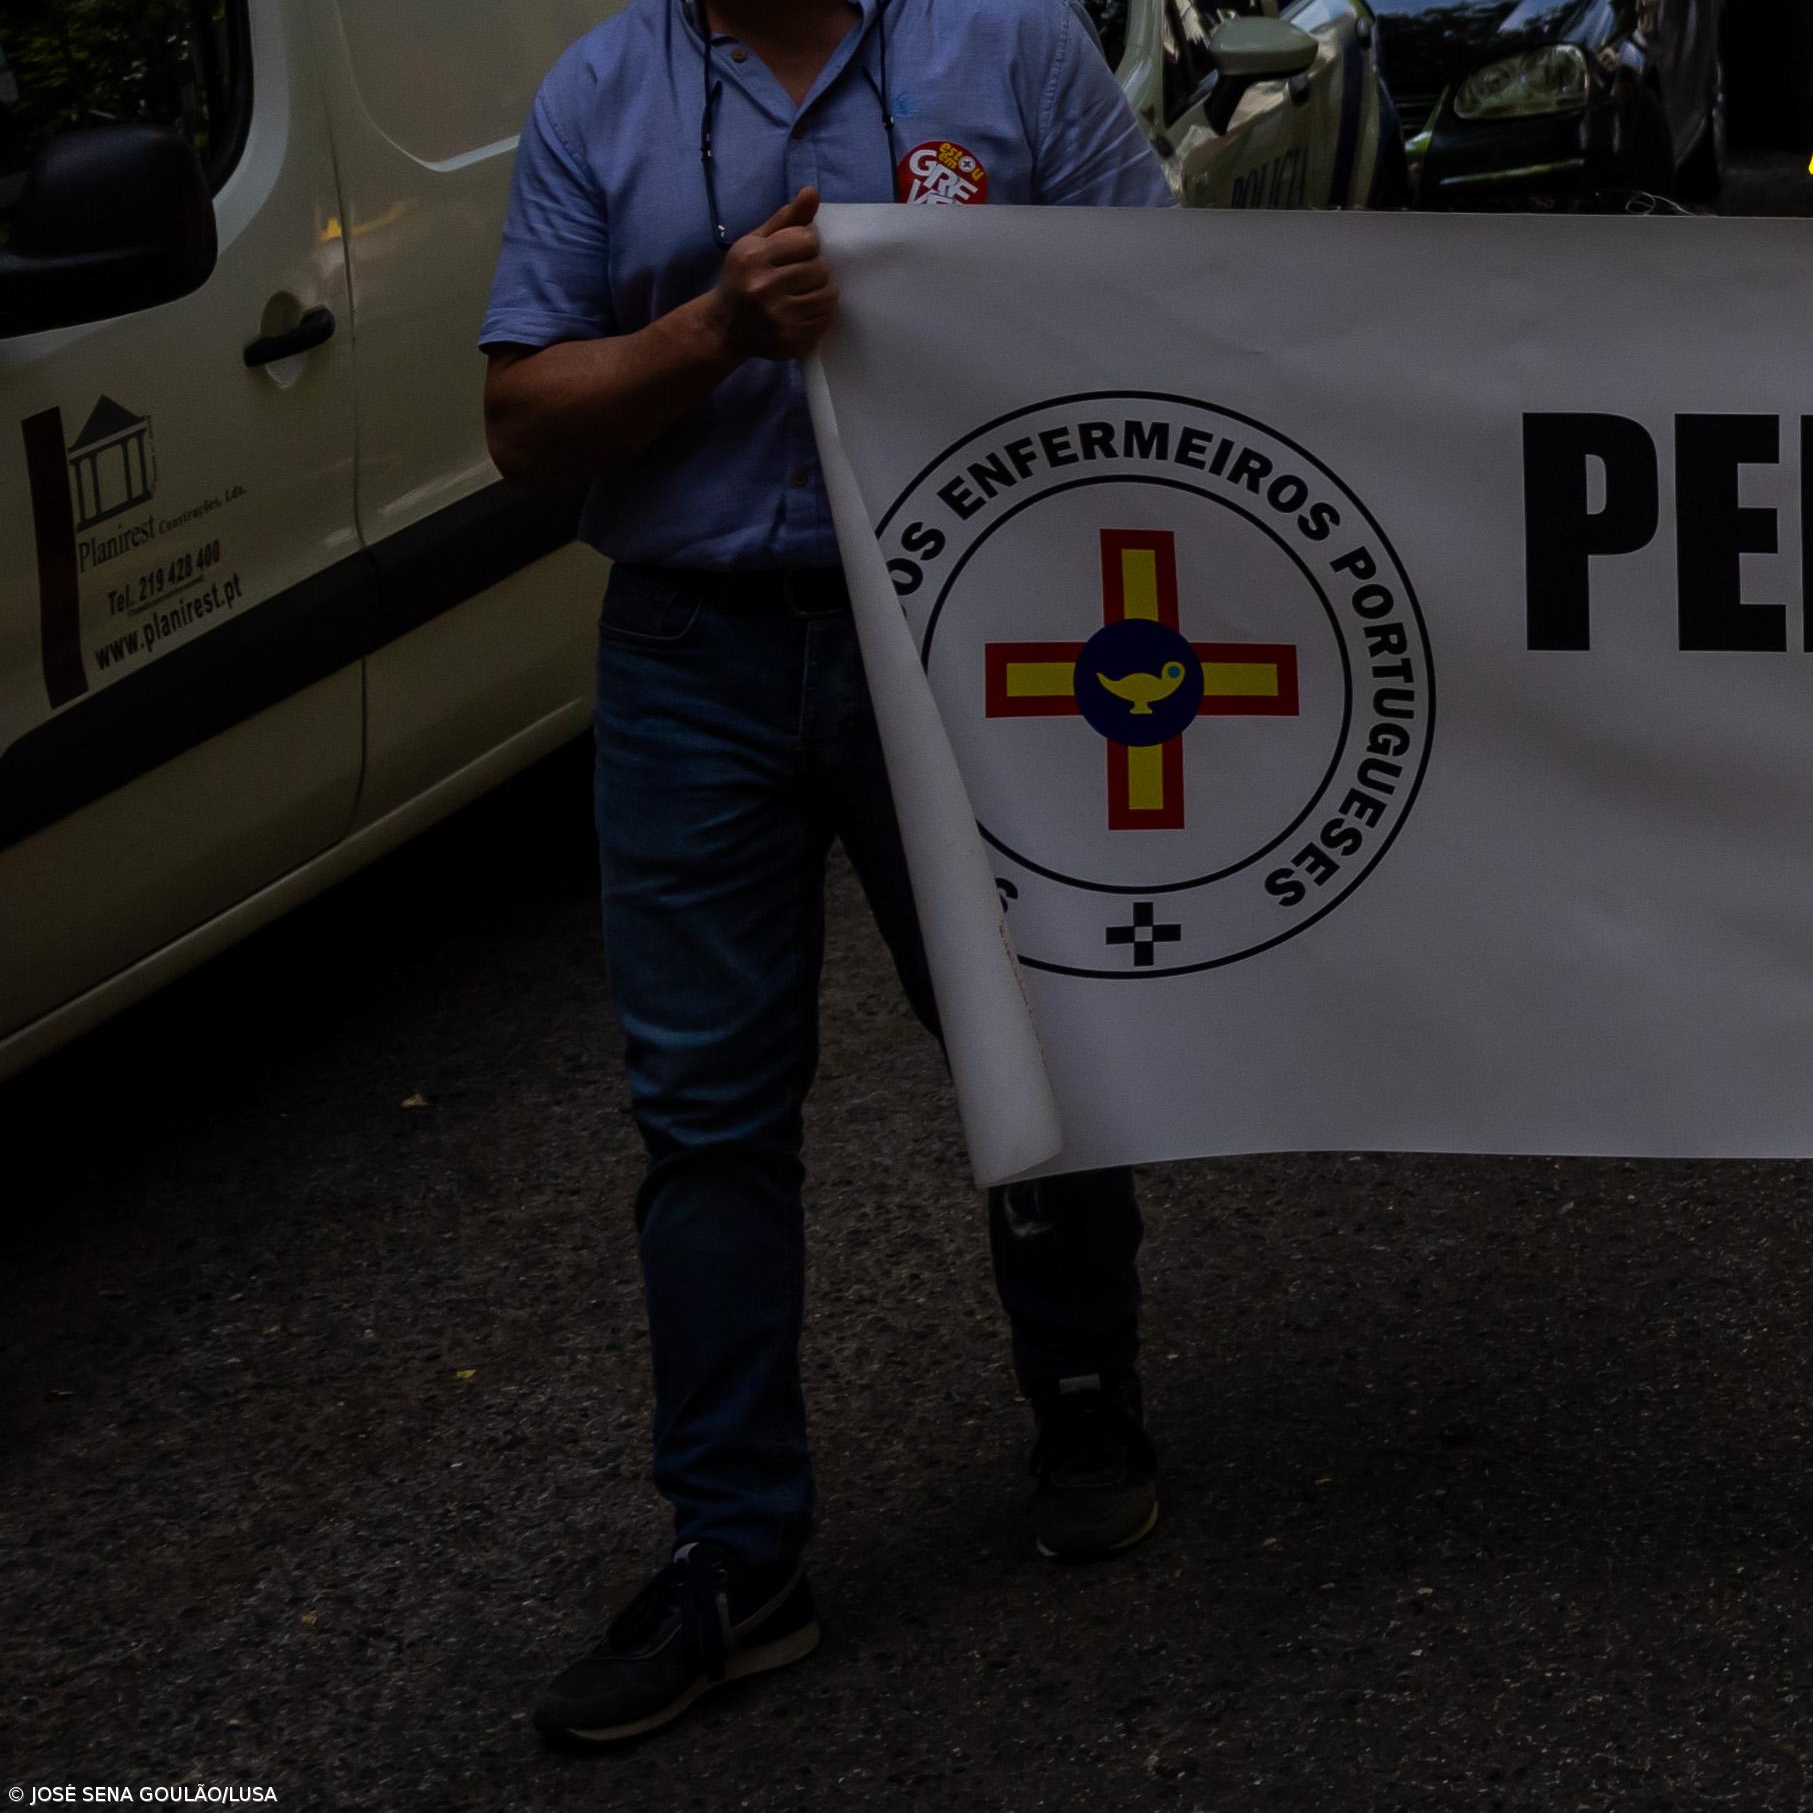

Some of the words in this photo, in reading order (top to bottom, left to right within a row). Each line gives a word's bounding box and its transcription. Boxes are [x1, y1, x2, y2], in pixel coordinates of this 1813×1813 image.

[78, 516, 156, 574] Planirest
[107, 585, 136, 616] Tel.
[139, 568, 164, 602] 219
[168, 552, 193, 583] 428
[197, 538, 220, 570] 400
[95, 572, 243, 670] www.planirest.pt
[887, 522, 945, 617] OS
[938, 420, 1340, 541] ENFERMEIROS
[1264, 546, 1414, 907] PORTUGUESES
